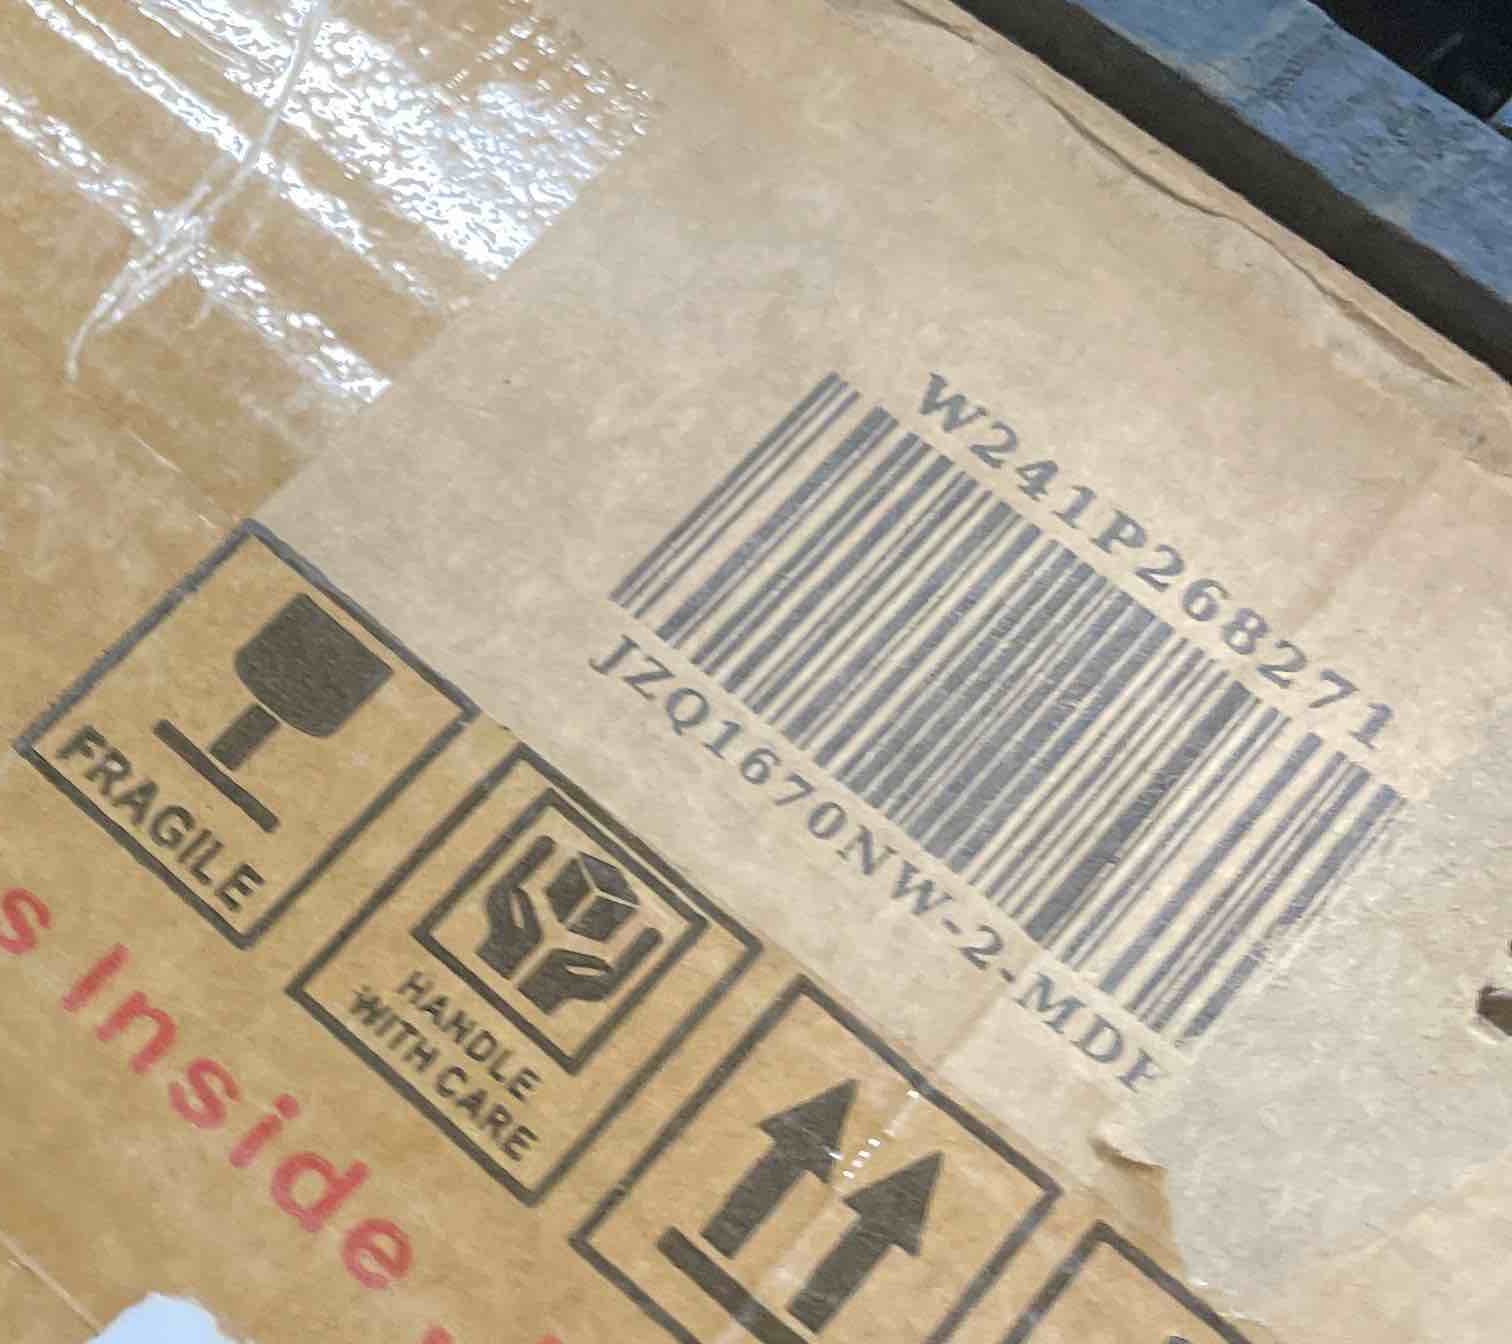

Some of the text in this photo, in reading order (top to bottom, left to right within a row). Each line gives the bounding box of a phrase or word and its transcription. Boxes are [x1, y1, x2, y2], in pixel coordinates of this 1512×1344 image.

[918, 371, 1395, 750] W241P268271
[55, 725, 264, 912] FRAGILE
[350, 984, 538, 1161] WITH CARE
[396, 970, 542, 1103] HANDLE
